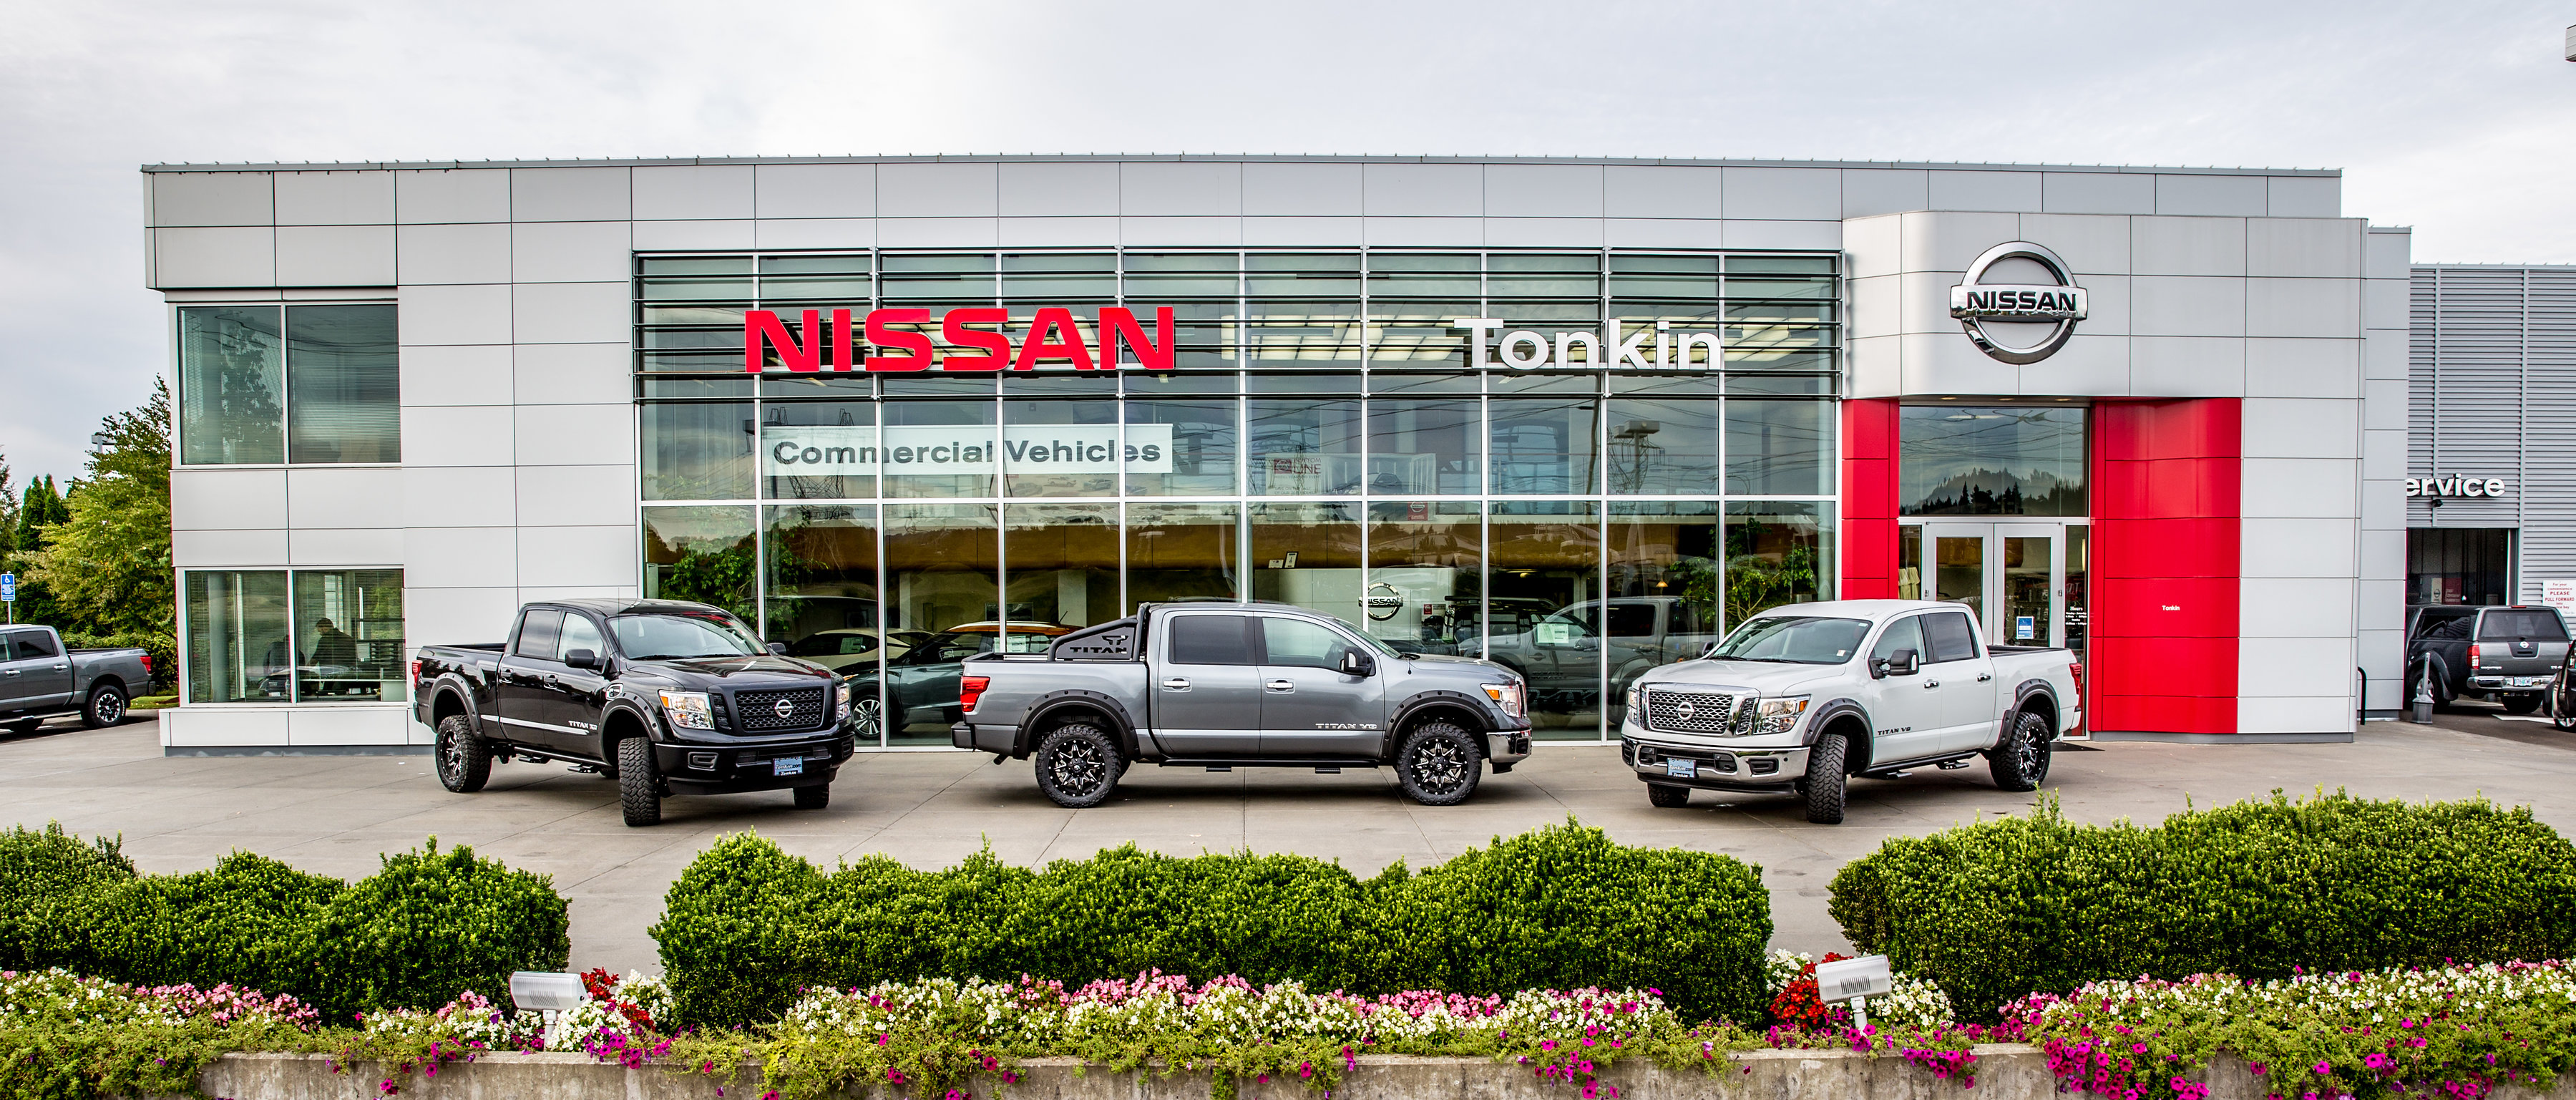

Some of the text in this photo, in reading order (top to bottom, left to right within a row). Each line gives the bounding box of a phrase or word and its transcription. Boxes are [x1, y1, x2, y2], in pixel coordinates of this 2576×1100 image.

[1967, 291, 2077, 311] NISSAN
[745, 306, 1174, 373] NISSAN
[1454, 318, 1721, 370] Tonkin
[773, 439, 1161, 464] Commercial Vehicles
[1294, 464, 1321, 474] LINE
[2406, 473, 2505, 497] ervice
[567, 720, 589, 729] TITAN
